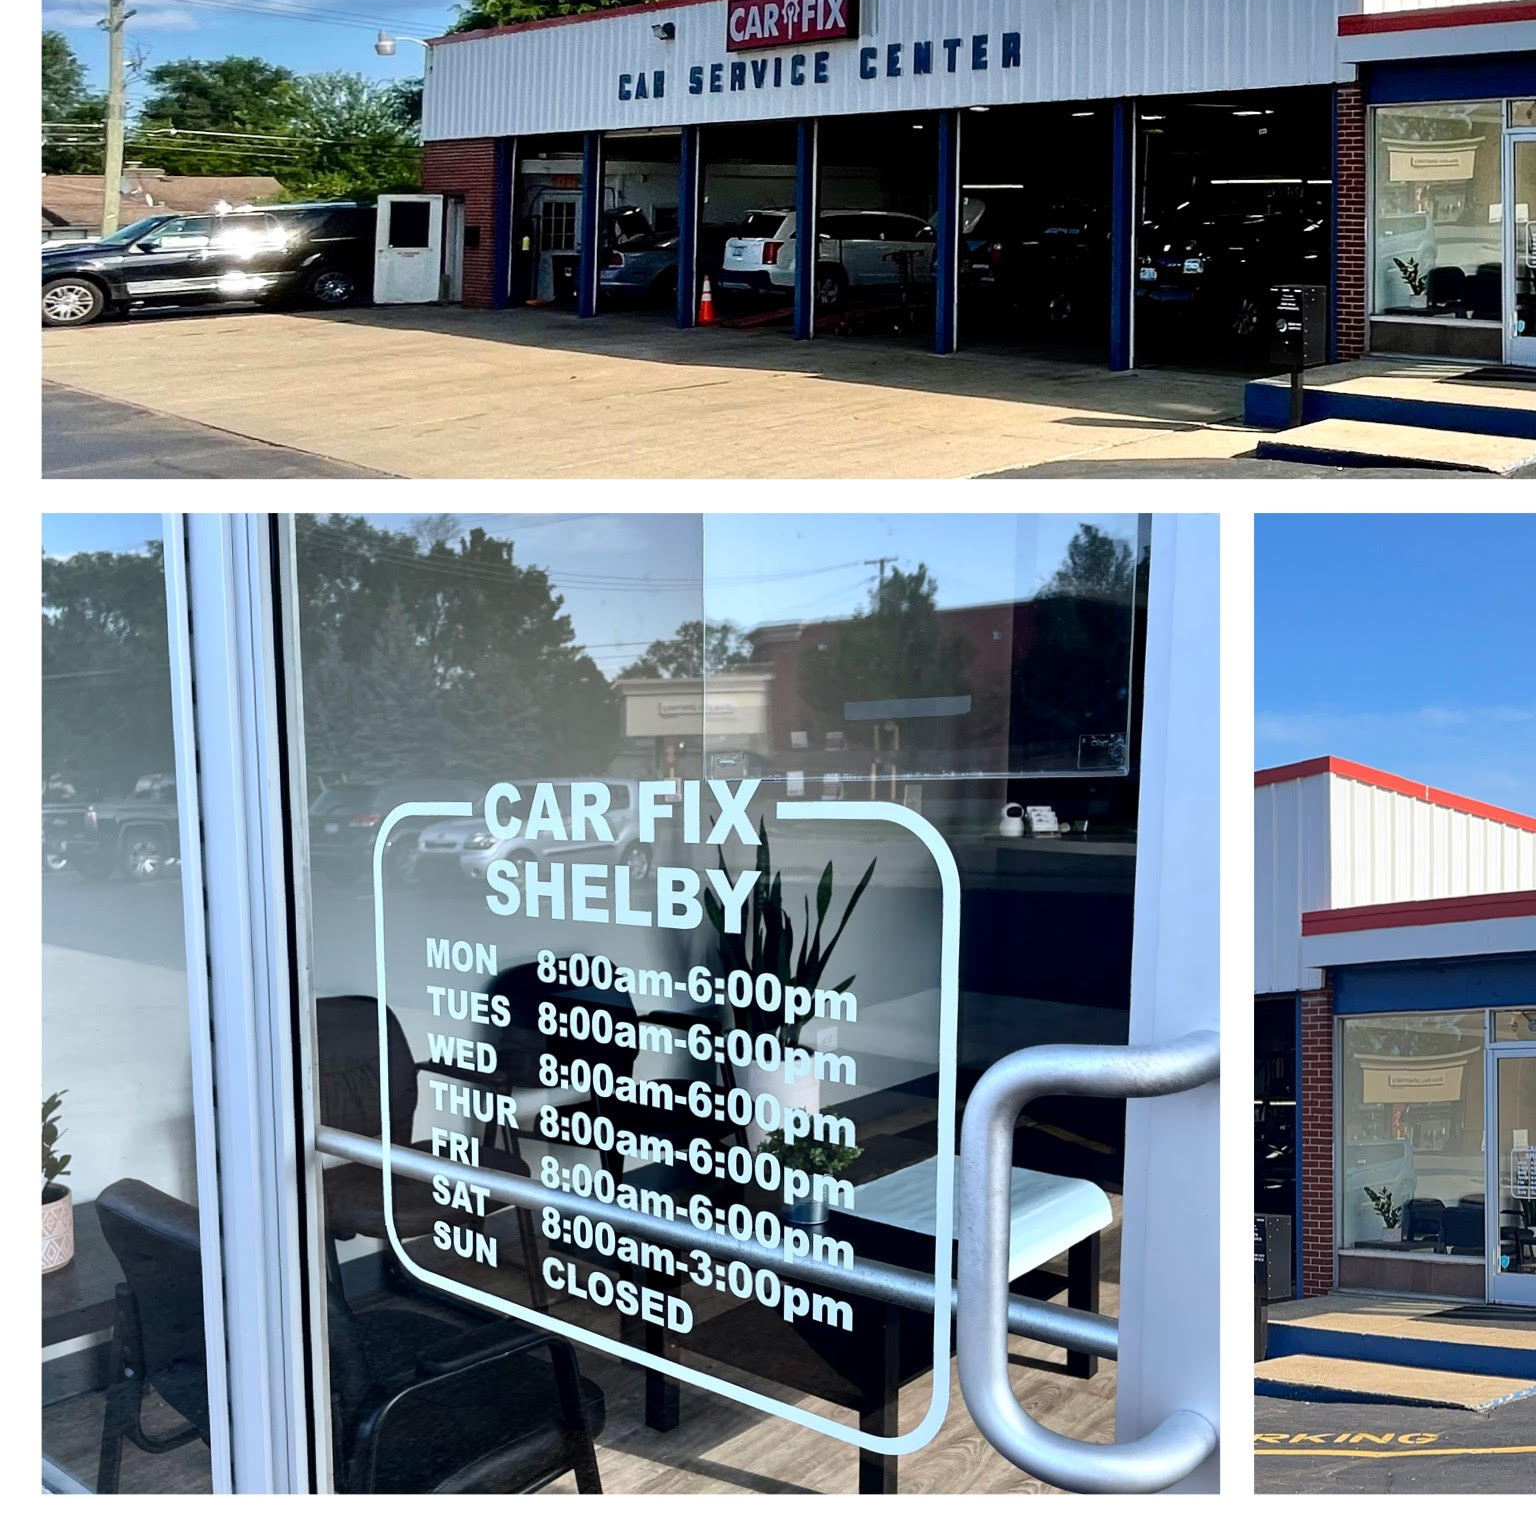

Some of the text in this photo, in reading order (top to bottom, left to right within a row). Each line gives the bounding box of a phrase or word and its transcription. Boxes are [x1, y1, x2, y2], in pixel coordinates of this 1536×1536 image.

[618, 32, 1021, 101] CAR SERVICE CENTER
[729, 4, 779, 42] CAR
[484, 779, 764, 846] CAR FIX
[485, 859, 763, 934] SHELBY
[426, 937, 858, 1024] MON 8:00am-6:00pm
[427, 985, 857, 1086] TUES 8:00am-6:00pm
[427, 1033, 857, 1148] WED 8:00am-6:00pm
[429, 1080, 856, 1210] THUR 8:00am-6:00pm
[431, 1127, 855, 1271] FRI 8:00am-6:00pm
[432, 1174, 854, 1332] SAT 8:00am-3:00pm
[432, 1221, 694, 1336] SUN CLOSED
[1254, 1432, 1440, 1445] RKING
